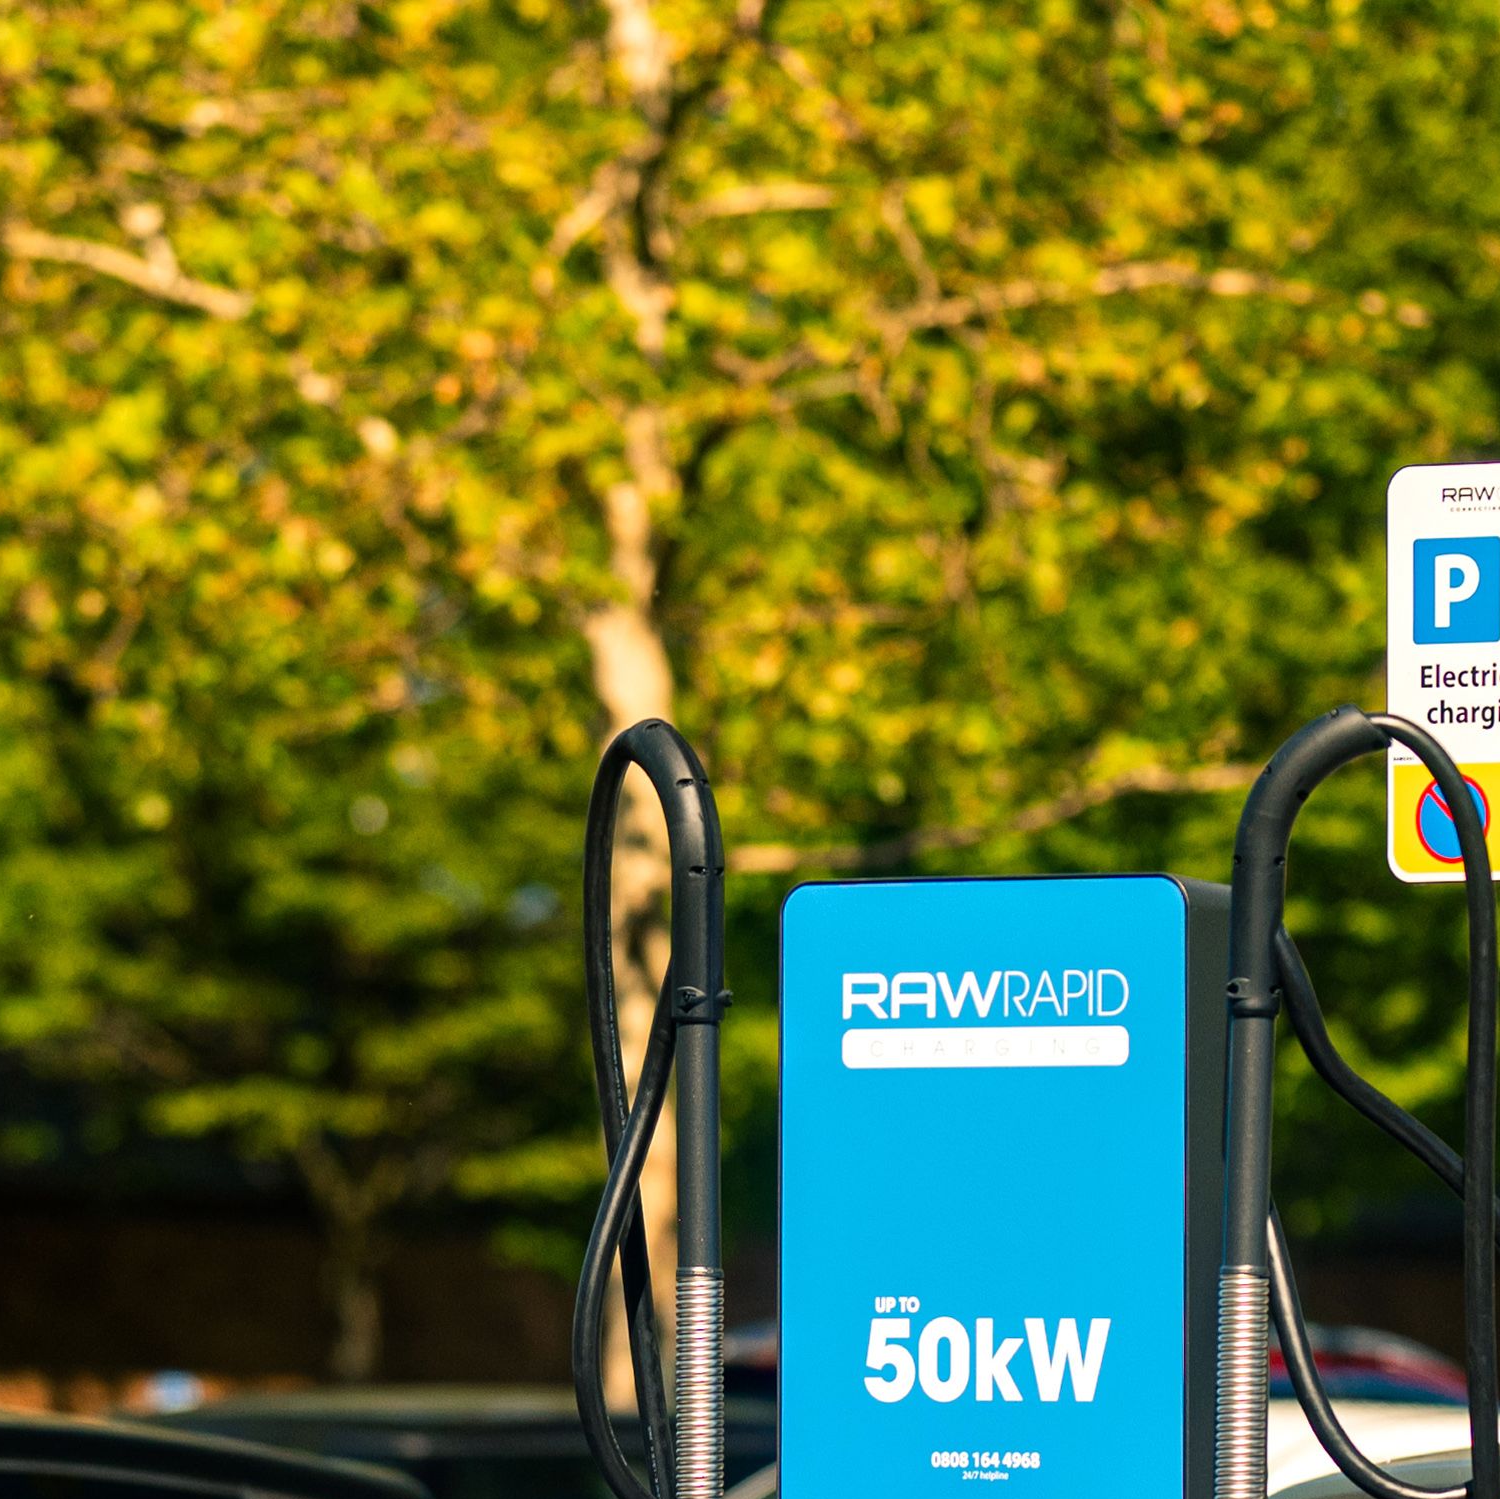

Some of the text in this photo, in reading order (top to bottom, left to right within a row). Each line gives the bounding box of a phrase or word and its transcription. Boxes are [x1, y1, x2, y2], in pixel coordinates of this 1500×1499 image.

[1434, 554, 1480, 628] P
[869, 1037, 1101, 1058] CHARGING
[875, 1296, 920, 1313] UP TO
[864, 1316, 1111, 1403] 50kW
[931, 1451, 1040, 1468] 0808 164 4968
[962, 1471, 1009, 1481] 24/7 helpline
